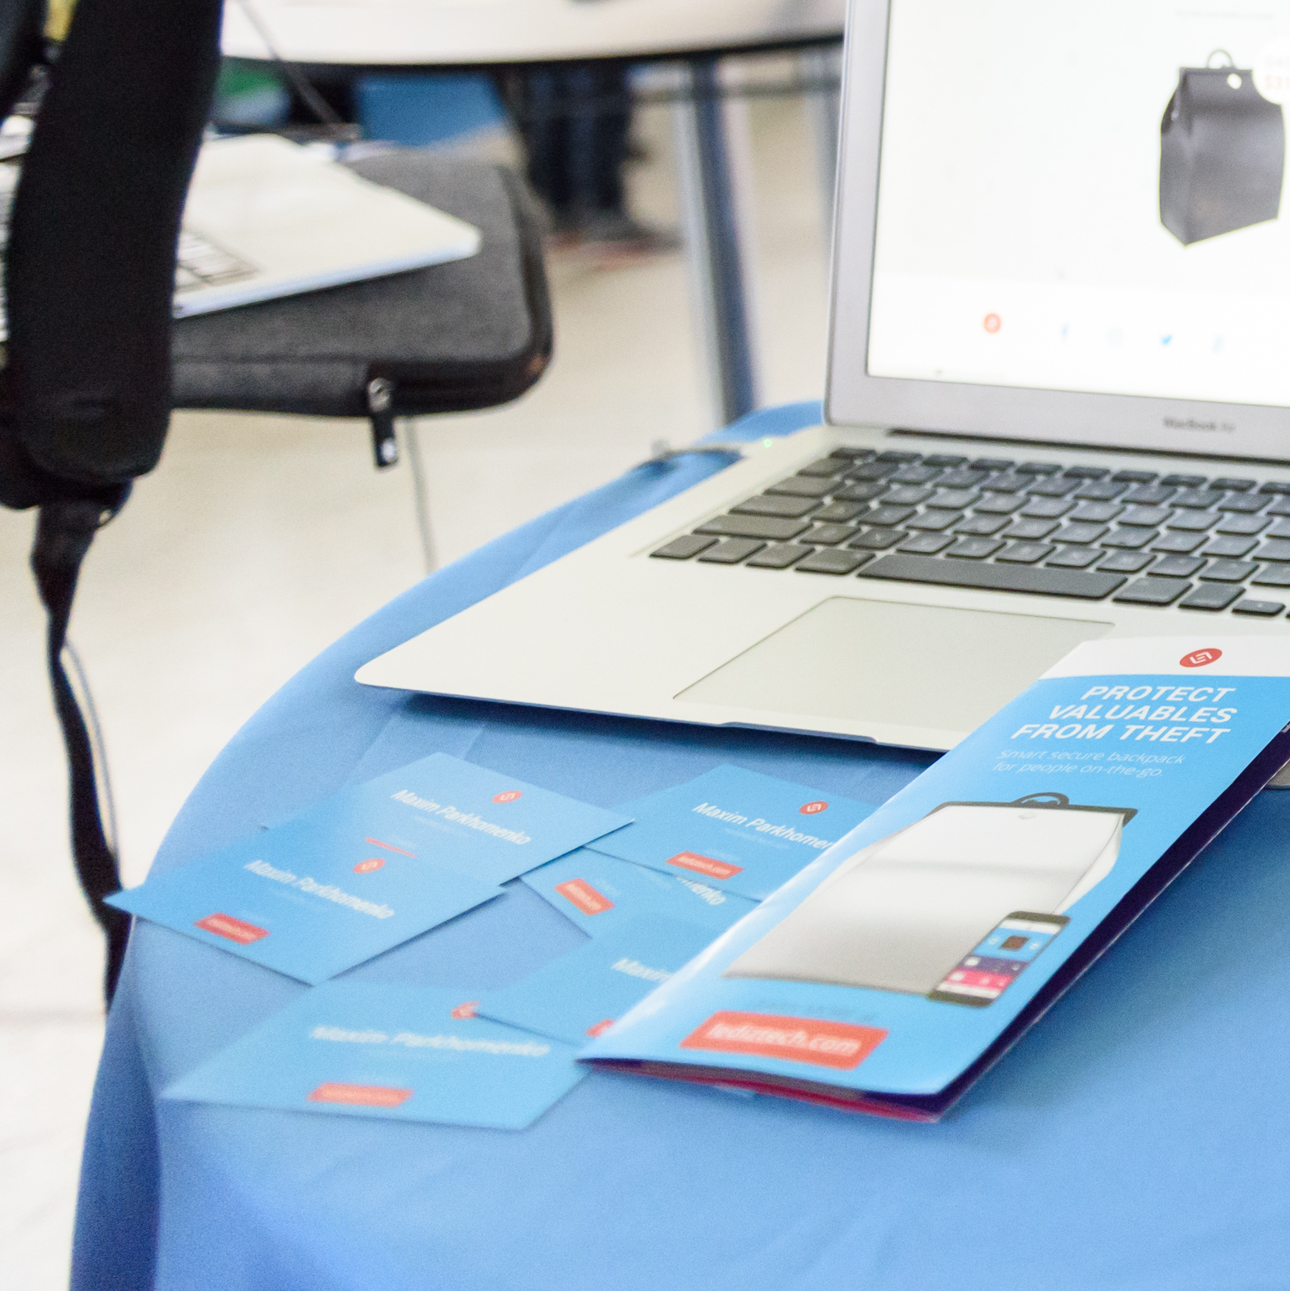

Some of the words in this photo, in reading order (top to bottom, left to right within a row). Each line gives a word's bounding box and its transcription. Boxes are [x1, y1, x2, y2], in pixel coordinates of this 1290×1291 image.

[1080, 686, 1236, 703] PROTECT
[1049, 704, 1238, 724] VALUABLES
[1010, 723, 1114, 740] FROM
[1119, 725, 1231, 744] THEFT
[1050, 751, 1105, 761] secure
[1107, 751, 1186, 766] backpack
[1015, 763, 1077, 775] people
[390, 789, 441, 813] Maxim
[692, 802, 748, 826] Maxim
